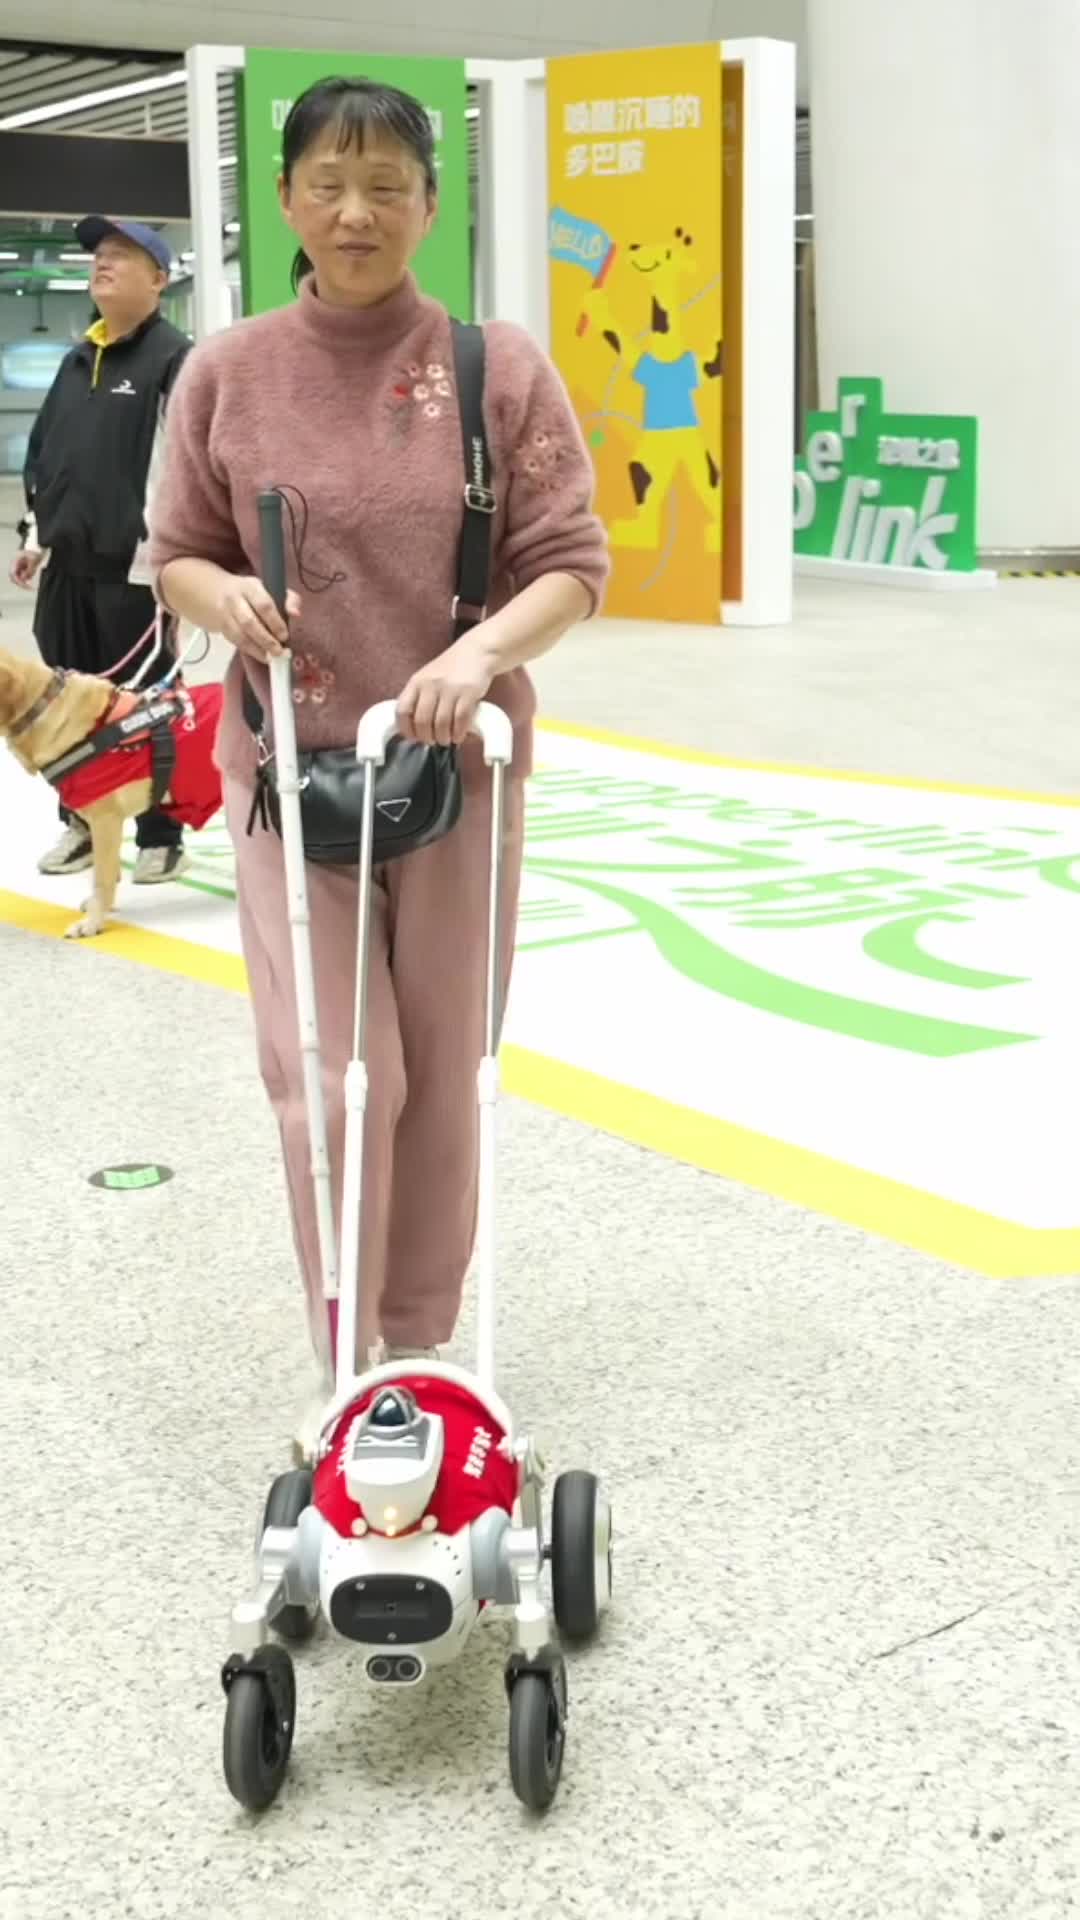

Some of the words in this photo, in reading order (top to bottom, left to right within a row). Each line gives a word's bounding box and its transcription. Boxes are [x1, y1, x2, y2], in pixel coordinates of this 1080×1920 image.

[563, 93, 703, 134] 唤醒沉睡的
[565, 140, 645, 178] 多巴胺
[832, 475, 958, 570] link
